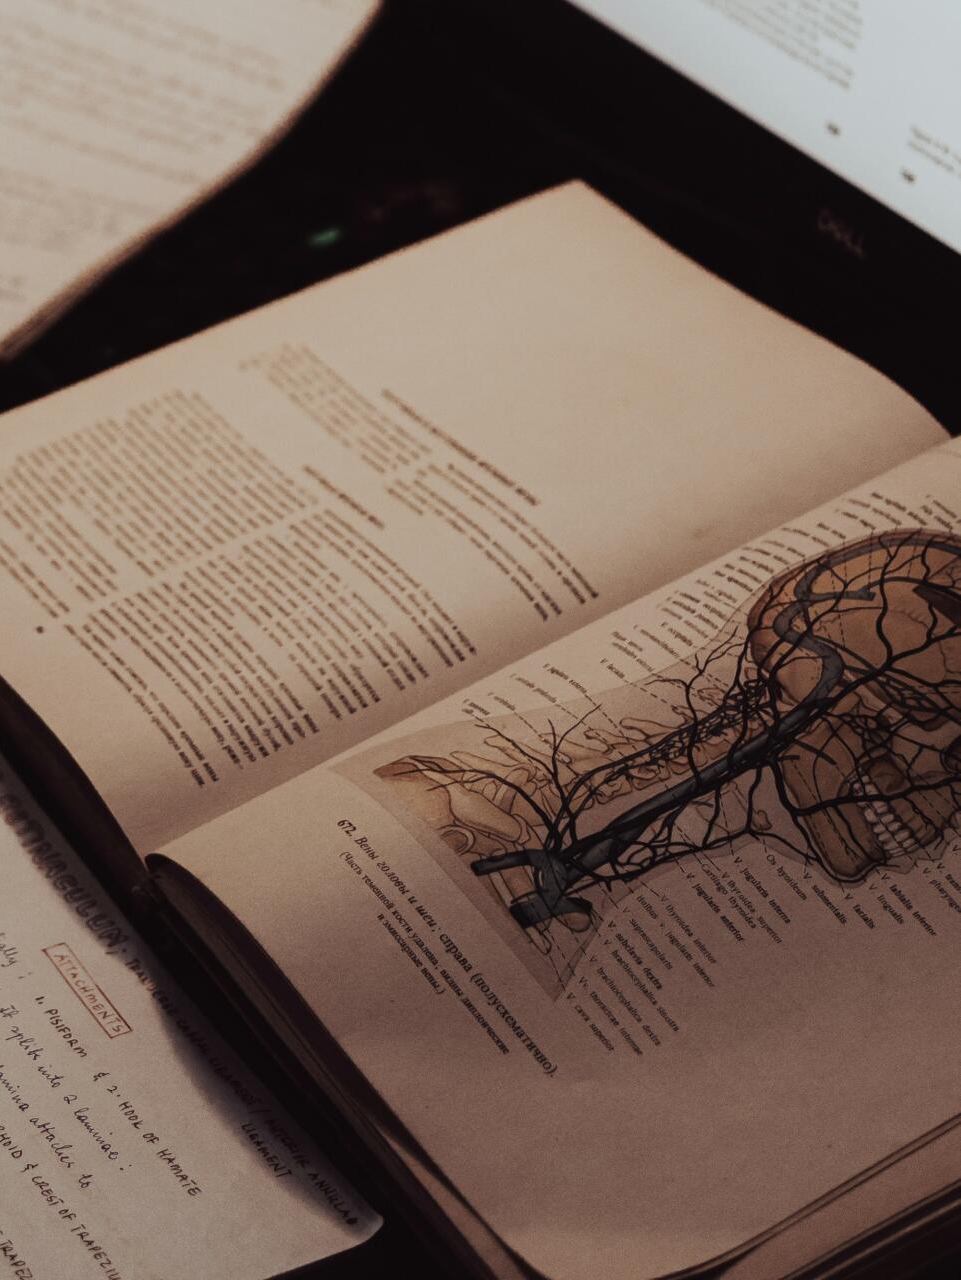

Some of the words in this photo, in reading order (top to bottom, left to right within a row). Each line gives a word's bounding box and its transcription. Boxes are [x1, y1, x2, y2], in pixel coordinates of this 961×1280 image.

[339, 851, 363, 876] (Часть
[361, 874, 394, 911] теменной
[391, 909, 413, 933] кости
[691, 882, 721, 914] jugularis
[719, 915, 745, 942] anterior
[739, 867, 770, 899] jugularis
[768, 898, 791, 924] interna
[336, 819, 357, 837] 672.
[354, 836, 380, 861] Вены
[376, 861, 410, 895] головы
[407, 895, 417, 905] и
[439, 933, 473, 973] справа
[469, 972, 558, 1078] (полусхематично).
[54, 954, 124, 1033] ATTACHMENTS
[574, 1005, 591, 1022] cava
[37, 1064, 65, 1089] into
[44, 1008, 88, 1058] PISIFORM
[118, 1100, 144, 1130] HOOK
[142, 1132, 160, 1144] OF
[156, 1148, 202, 1197] HAMATE
[28, 1117, 75, 1169] attaches
[78, 1173, 94, 1189] to
[239, 1119, 293, 1181] LIGAMENT
[31, 1175, 65, 1207] CREST
[58, 1208, 77, 1221] OF
